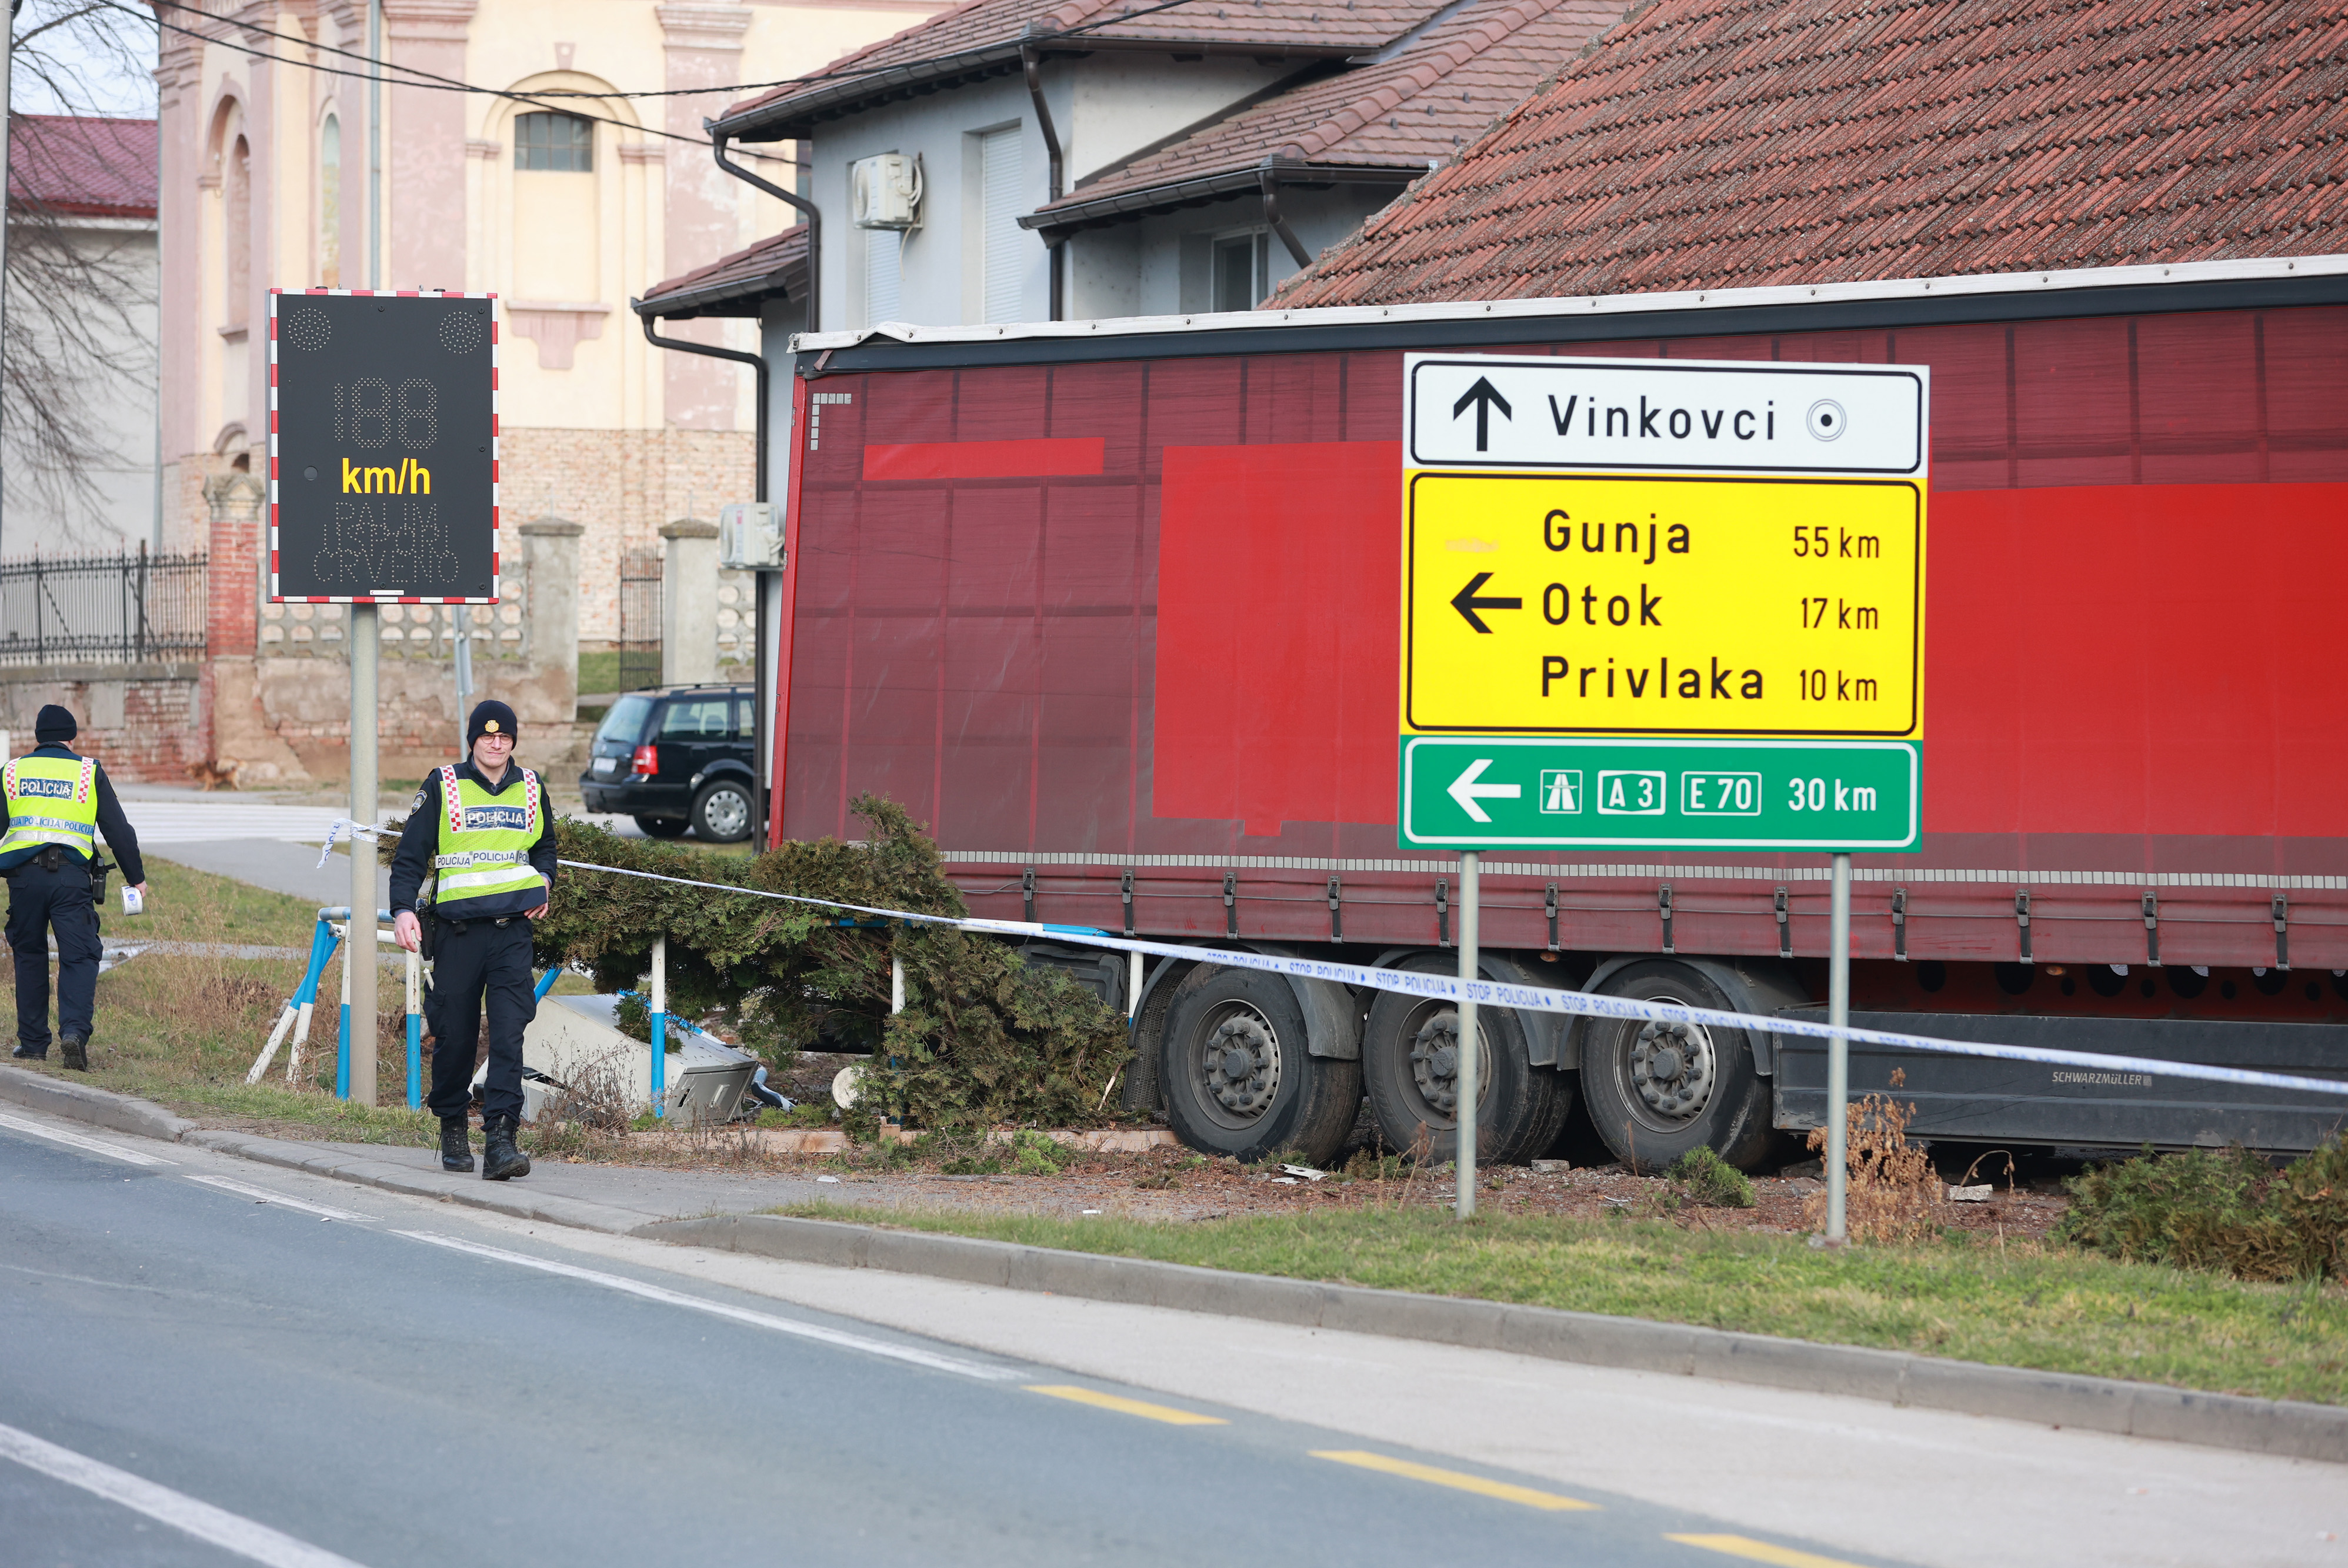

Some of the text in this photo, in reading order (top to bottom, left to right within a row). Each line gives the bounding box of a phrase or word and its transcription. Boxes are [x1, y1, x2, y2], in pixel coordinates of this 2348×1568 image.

[1548, 395, 1773, 440] Vinkovci
[342, 458, 431, 495] km/h
[1545, 509, 1879, 565] Gunja 55 km
[1543, 583, 1877, 629] Otok 17 km
[1542, 656, 1876, 700] Privlaka 10 km
[21, 780, 71, 796] POLICIJA
[1609, 778, 1876, 811] A 3 E 70 30 km
[64, 822, 94, 834] POLICIJA
[467, 811, 524, 825] POLICIJA
[438, 856, 471, 866] POLICIJA
[473, 852, 515, 861] POLICIJA
[1375, 972, 1400, 988] STOP
[1405, 976, 1447, 994] POLICIJA
[1466, 983, 1492, 1000] STOP
[1496, 986, 1543, 1006] POLICIJA
[1561, 994, 1588, 1011] STOP
[1593, 999, 1640, 1017] POLICIJA
